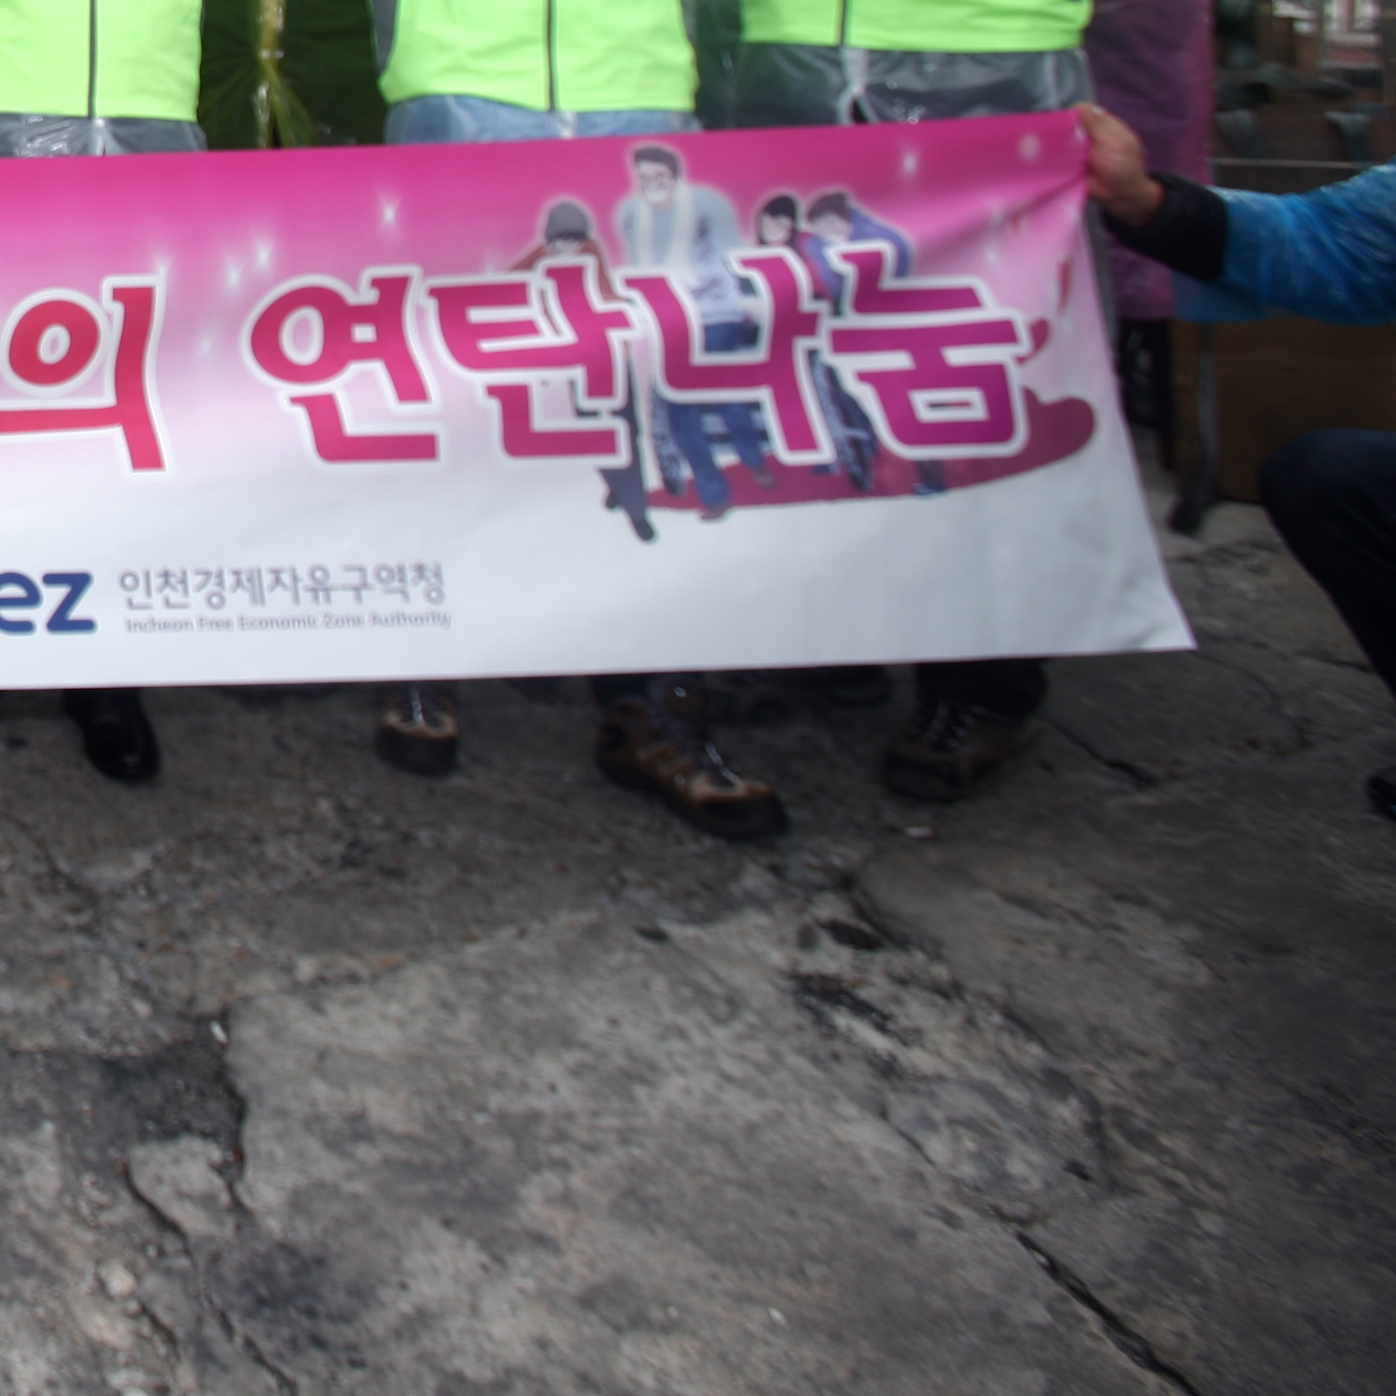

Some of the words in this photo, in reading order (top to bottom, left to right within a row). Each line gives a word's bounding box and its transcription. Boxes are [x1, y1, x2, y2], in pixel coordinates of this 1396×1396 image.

[118, 559, 447, 610] 인천경제자유구역청
[126, 618, 195, 633] Incheon
[199, 617, 233, 631] Free
[240, 614, 317, 630] Economic
[323, 613, 366, 629] Zone
[371, 610, 452, 631] Authority
